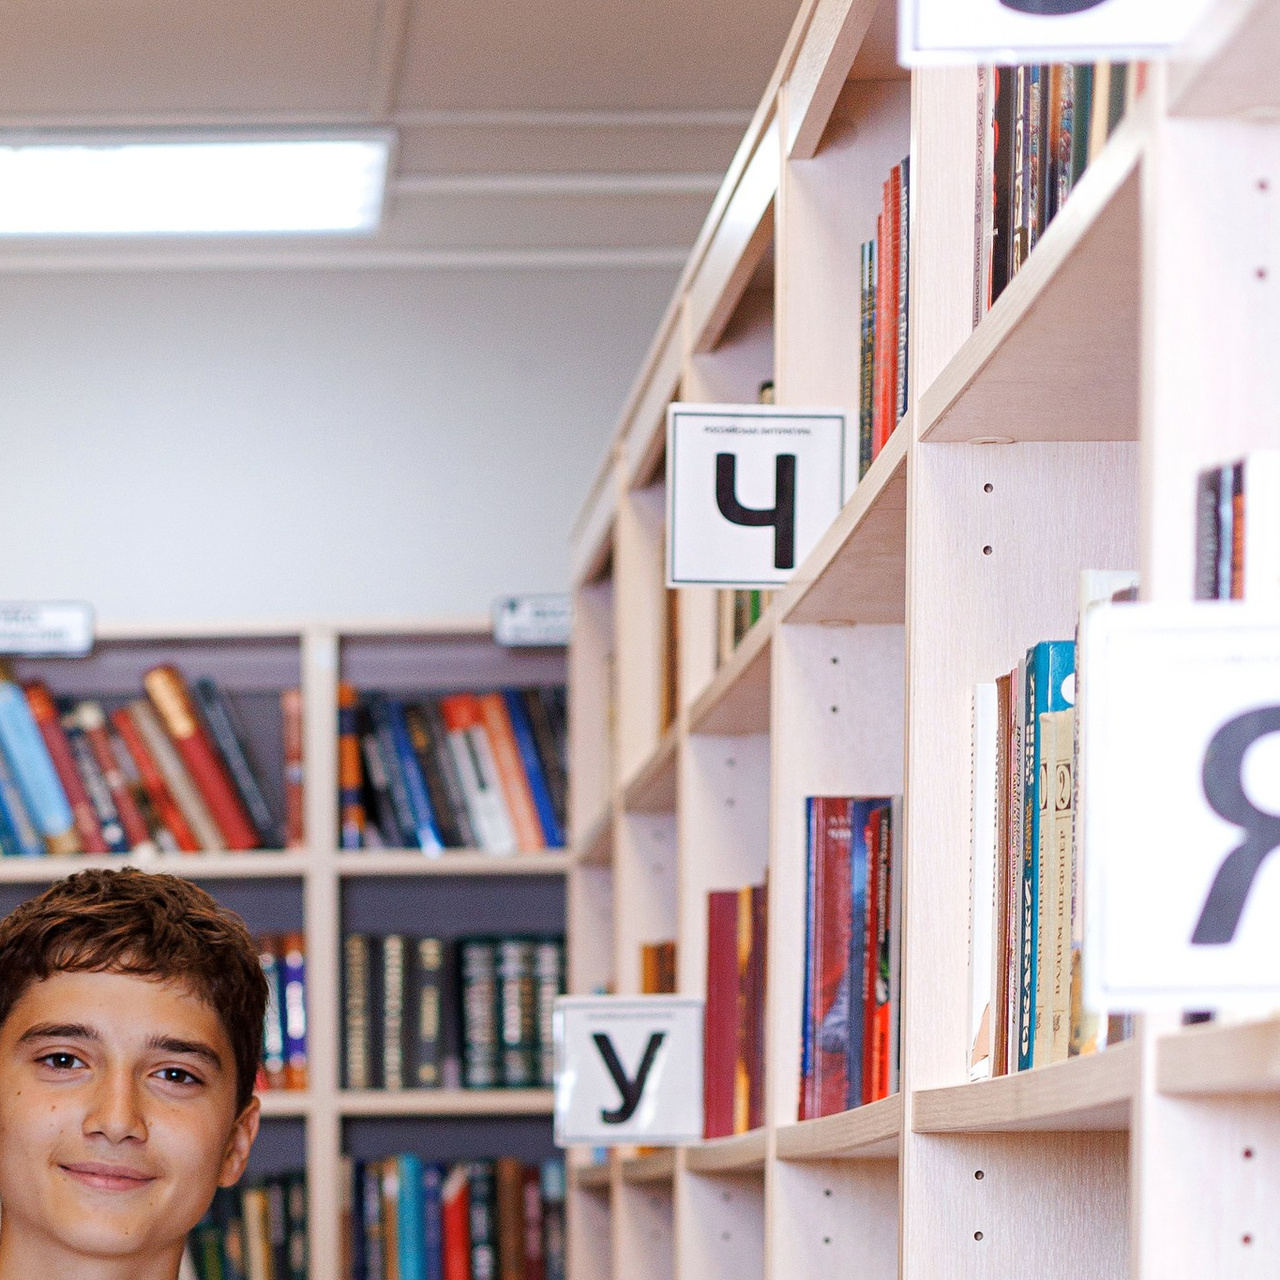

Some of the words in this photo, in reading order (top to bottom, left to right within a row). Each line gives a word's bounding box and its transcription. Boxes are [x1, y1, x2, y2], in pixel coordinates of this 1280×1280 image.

[716, 453, 795, 569] Ч
[1057, 830, 1065, 918] ШЕФНЕР
[1189, 705, 1280, 945] Я
[591, 1032, 666, 1124] У
